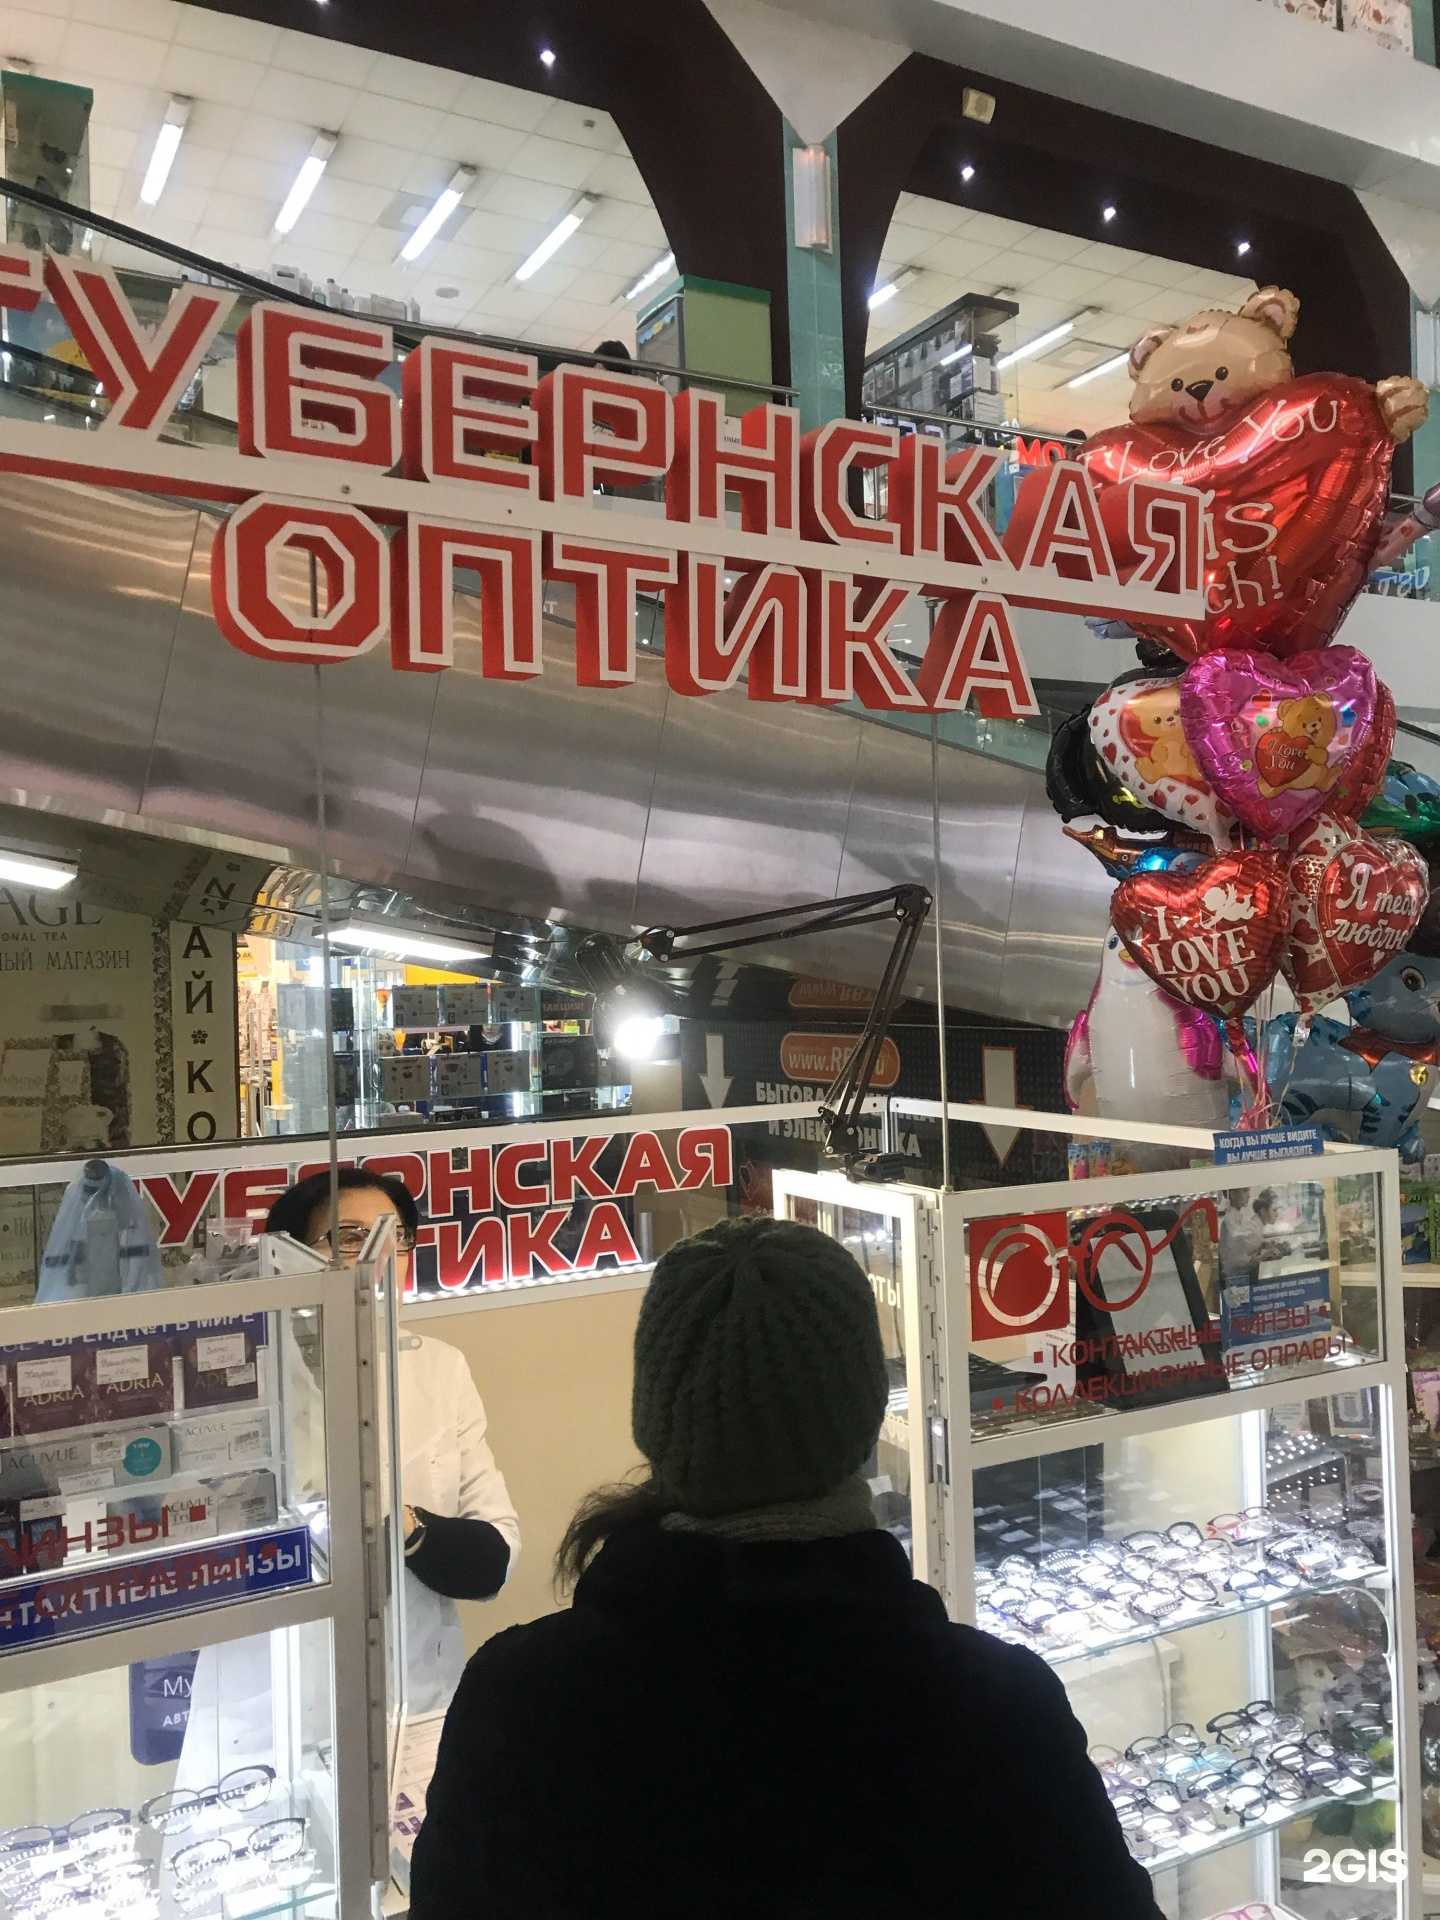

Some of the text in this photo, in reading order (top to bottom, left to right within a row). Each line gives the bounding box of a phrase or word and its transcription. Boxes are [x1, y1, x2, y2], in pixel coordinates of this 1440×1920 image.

[0, 243, 1207, 600] УБЕРНСКАЯ
[1203, 489, 1278, 560] is
[1205, 555, 1284, 614] ch!
[212, 492, 1042, 718] ОПТИКА
[1336, 862, 1374, 911] Я
[1, 931, 37, 942] ONAL
[1153, 905, 1172, 940] I
[46, 950, 130, 971] МАГАЗИН
[1150, 925, 1256, 976] LOVE
[1166, 964, 1251, 1004] YOU
[755, 1081, 826, 1104] БЫТОВА
[1219, 1135, 1244, 1149] КОГДА
[1246, 1134, 1259, 1146] ВЫ
[1251, 1333, 1347, 1371] ОПРАВЫ
